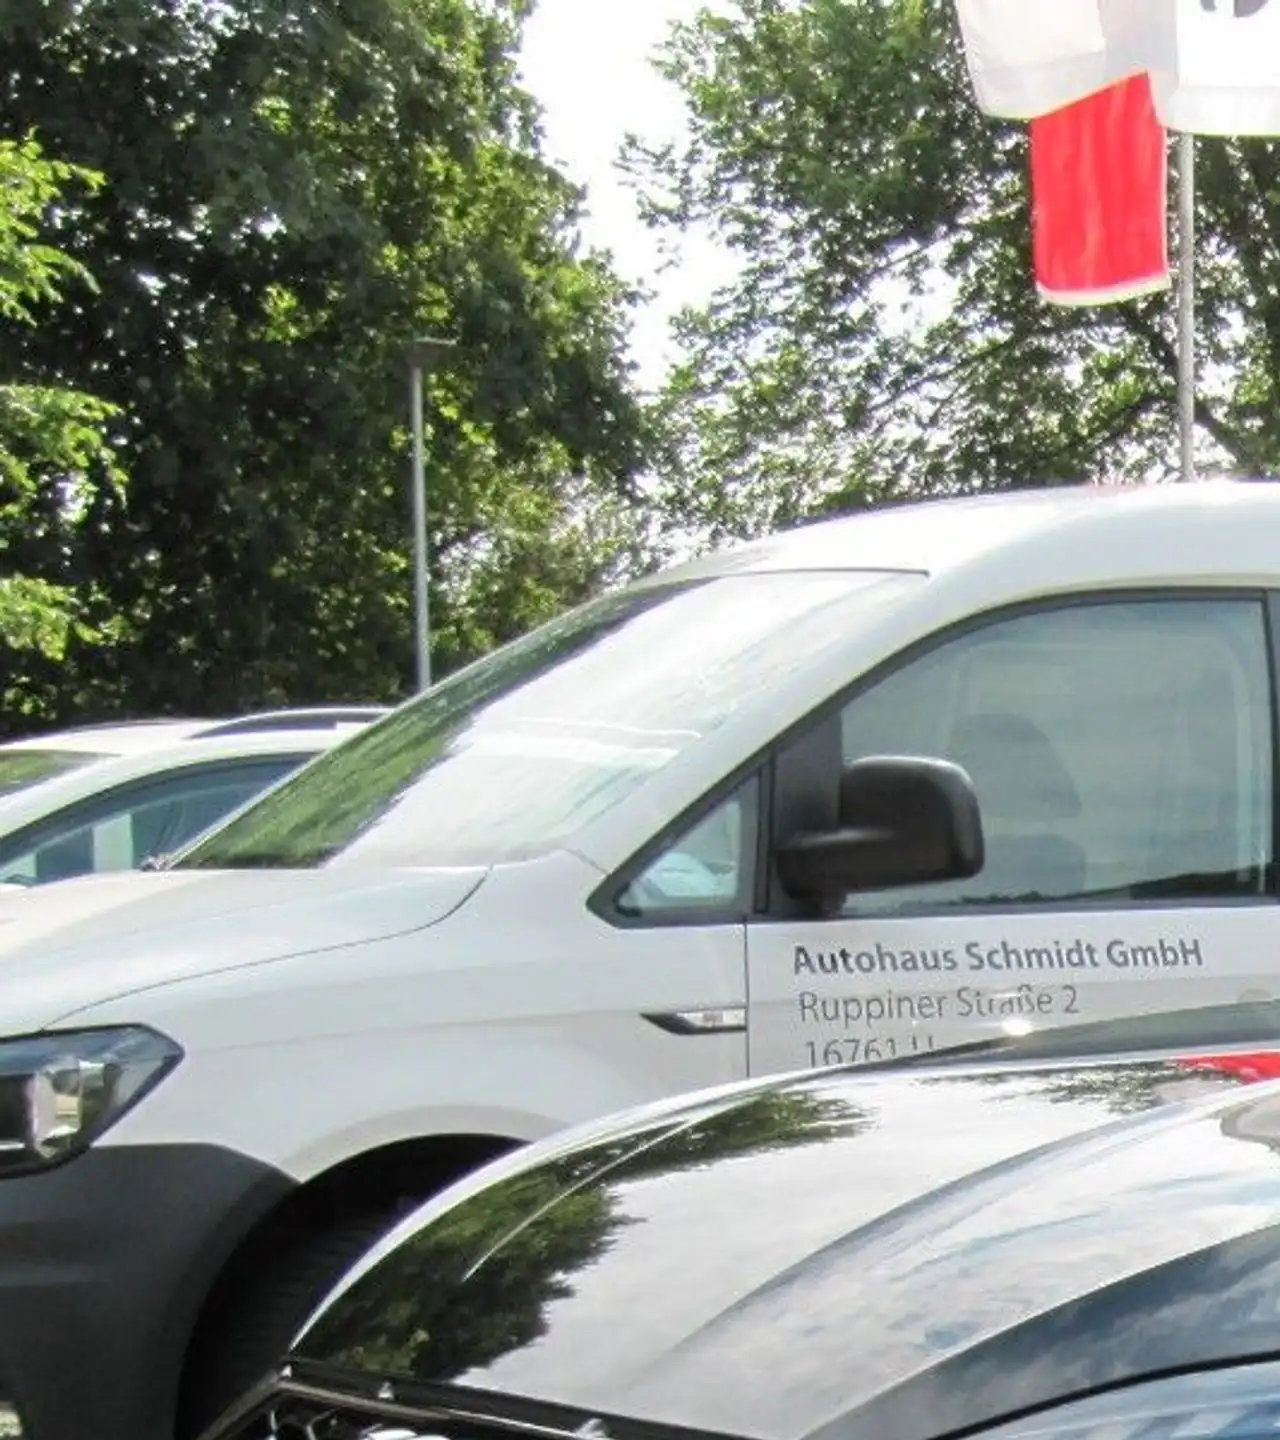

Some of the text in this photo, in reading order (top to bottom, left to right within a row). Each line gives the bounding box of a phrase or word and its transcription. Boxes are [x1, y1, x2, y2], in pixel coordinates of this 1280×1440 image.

[794, 937, 1204, 976] Autohaus Schmidt GmbH
[800, 984, 1080, 1029] Ruppiner Straße 2
